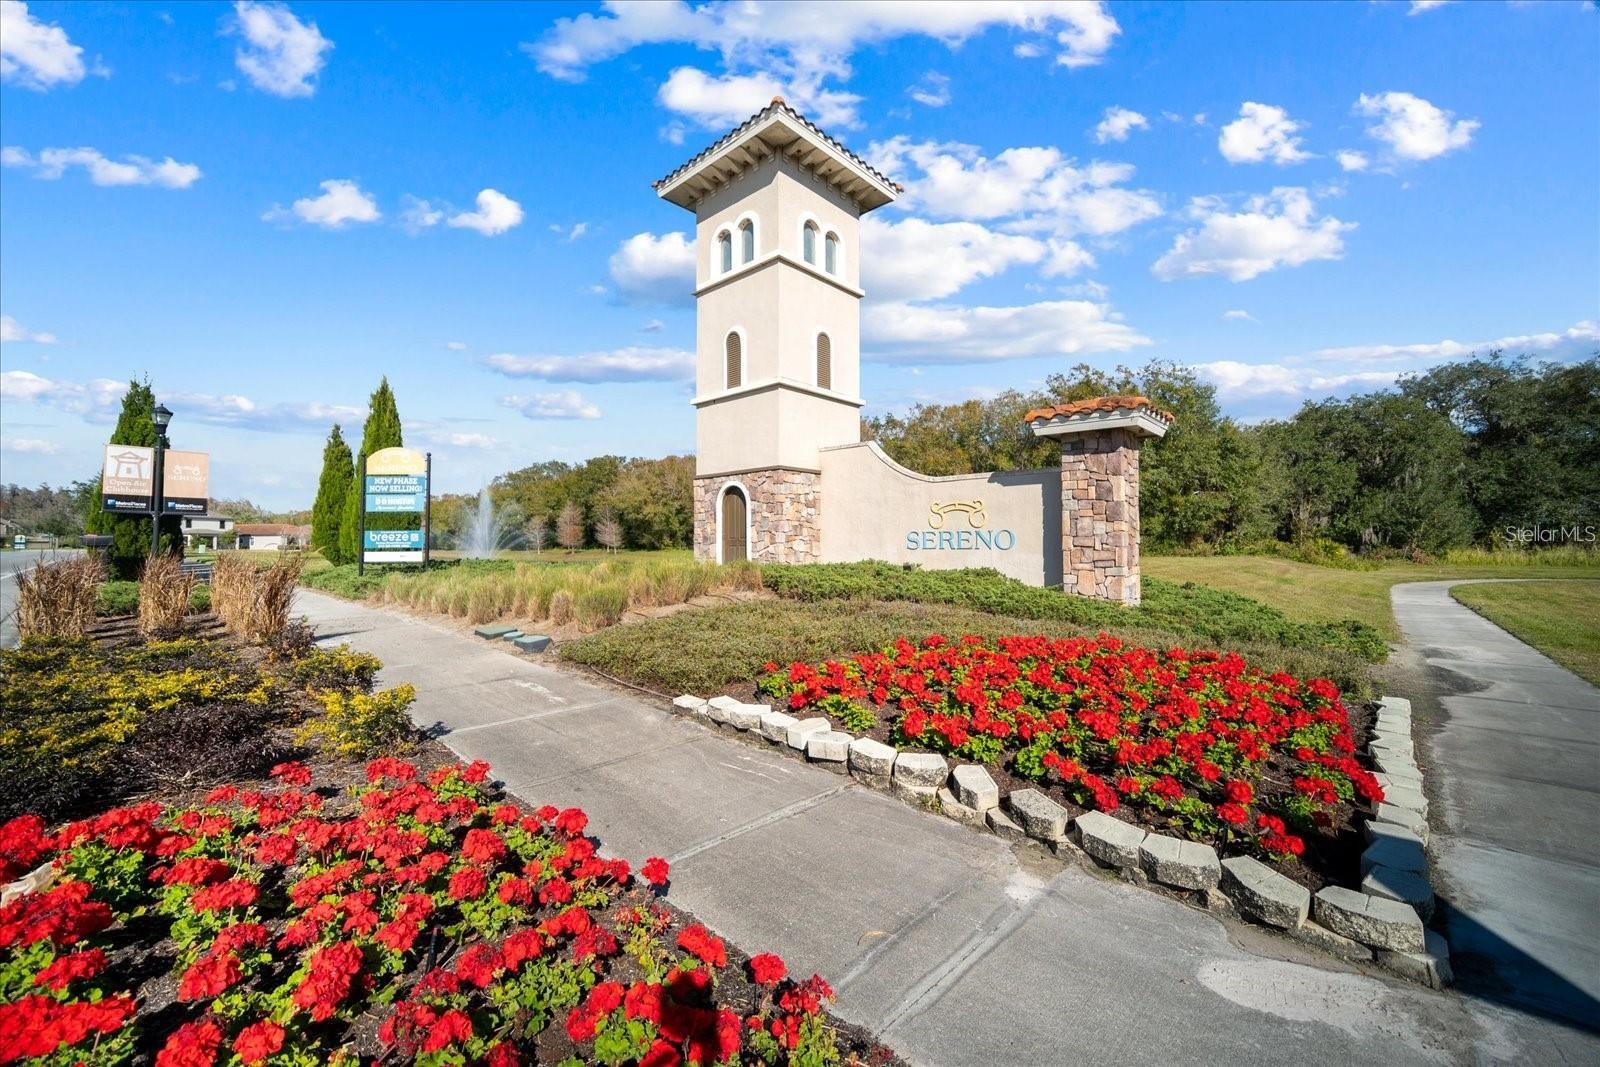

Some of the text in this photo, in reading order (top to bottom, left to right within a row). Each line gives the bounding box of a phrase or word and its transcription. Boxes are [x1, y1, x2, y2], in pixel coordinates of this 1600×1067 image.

[109, 479, 132, 488] Open
[374, 477, 418, 485] NEW PHASE
[105, 485, 149, 494] Clubhouse
[369, 531, 409, 542] breeze
[906, 528, 1017, 551] SERENO
